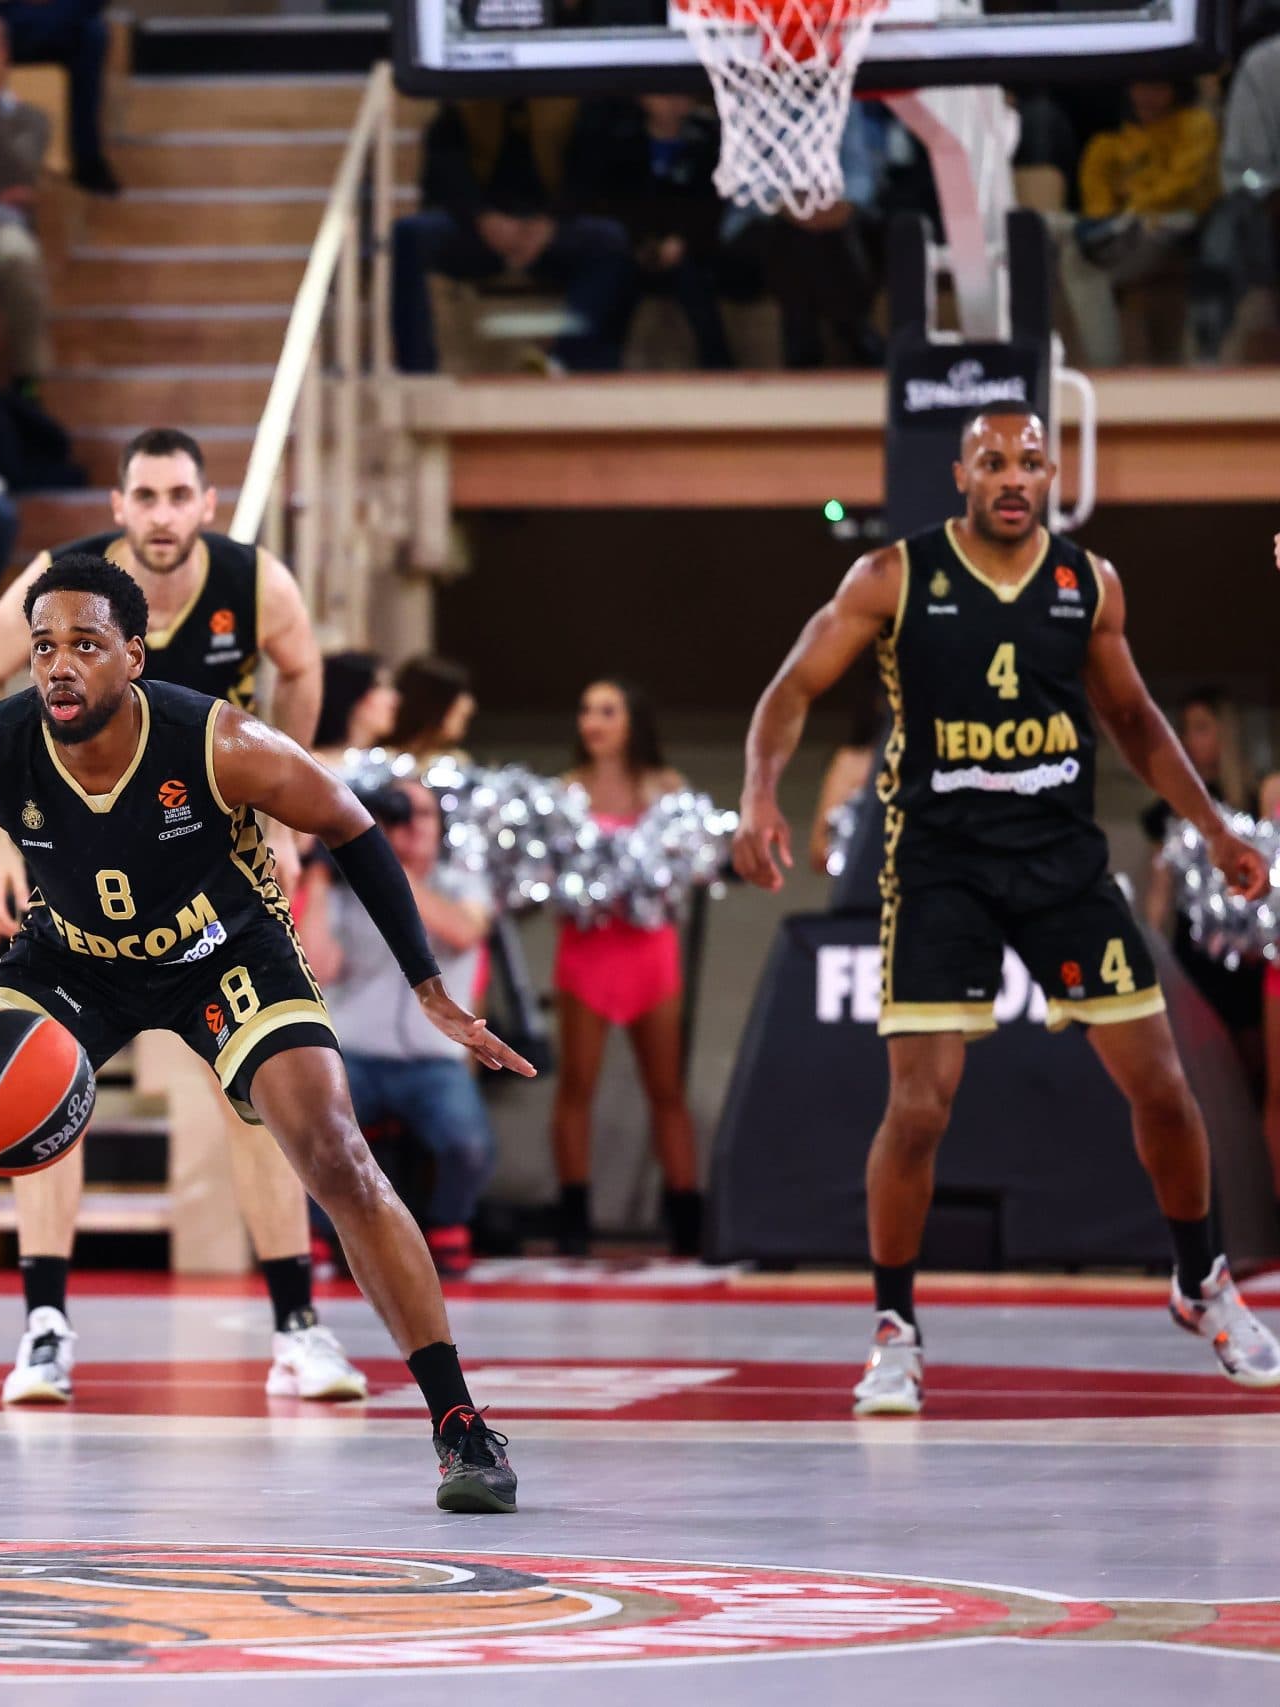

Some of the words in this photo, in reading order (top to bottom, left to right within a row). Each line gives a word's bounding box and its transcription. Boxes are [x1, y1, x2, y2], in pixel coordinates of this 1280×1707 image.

[987, 641, 1020, 699] 4
[95, 869, 137, 920] 8
[1100, 938, 1136, 993] 4
[220, 965, 260, 1024] 8
